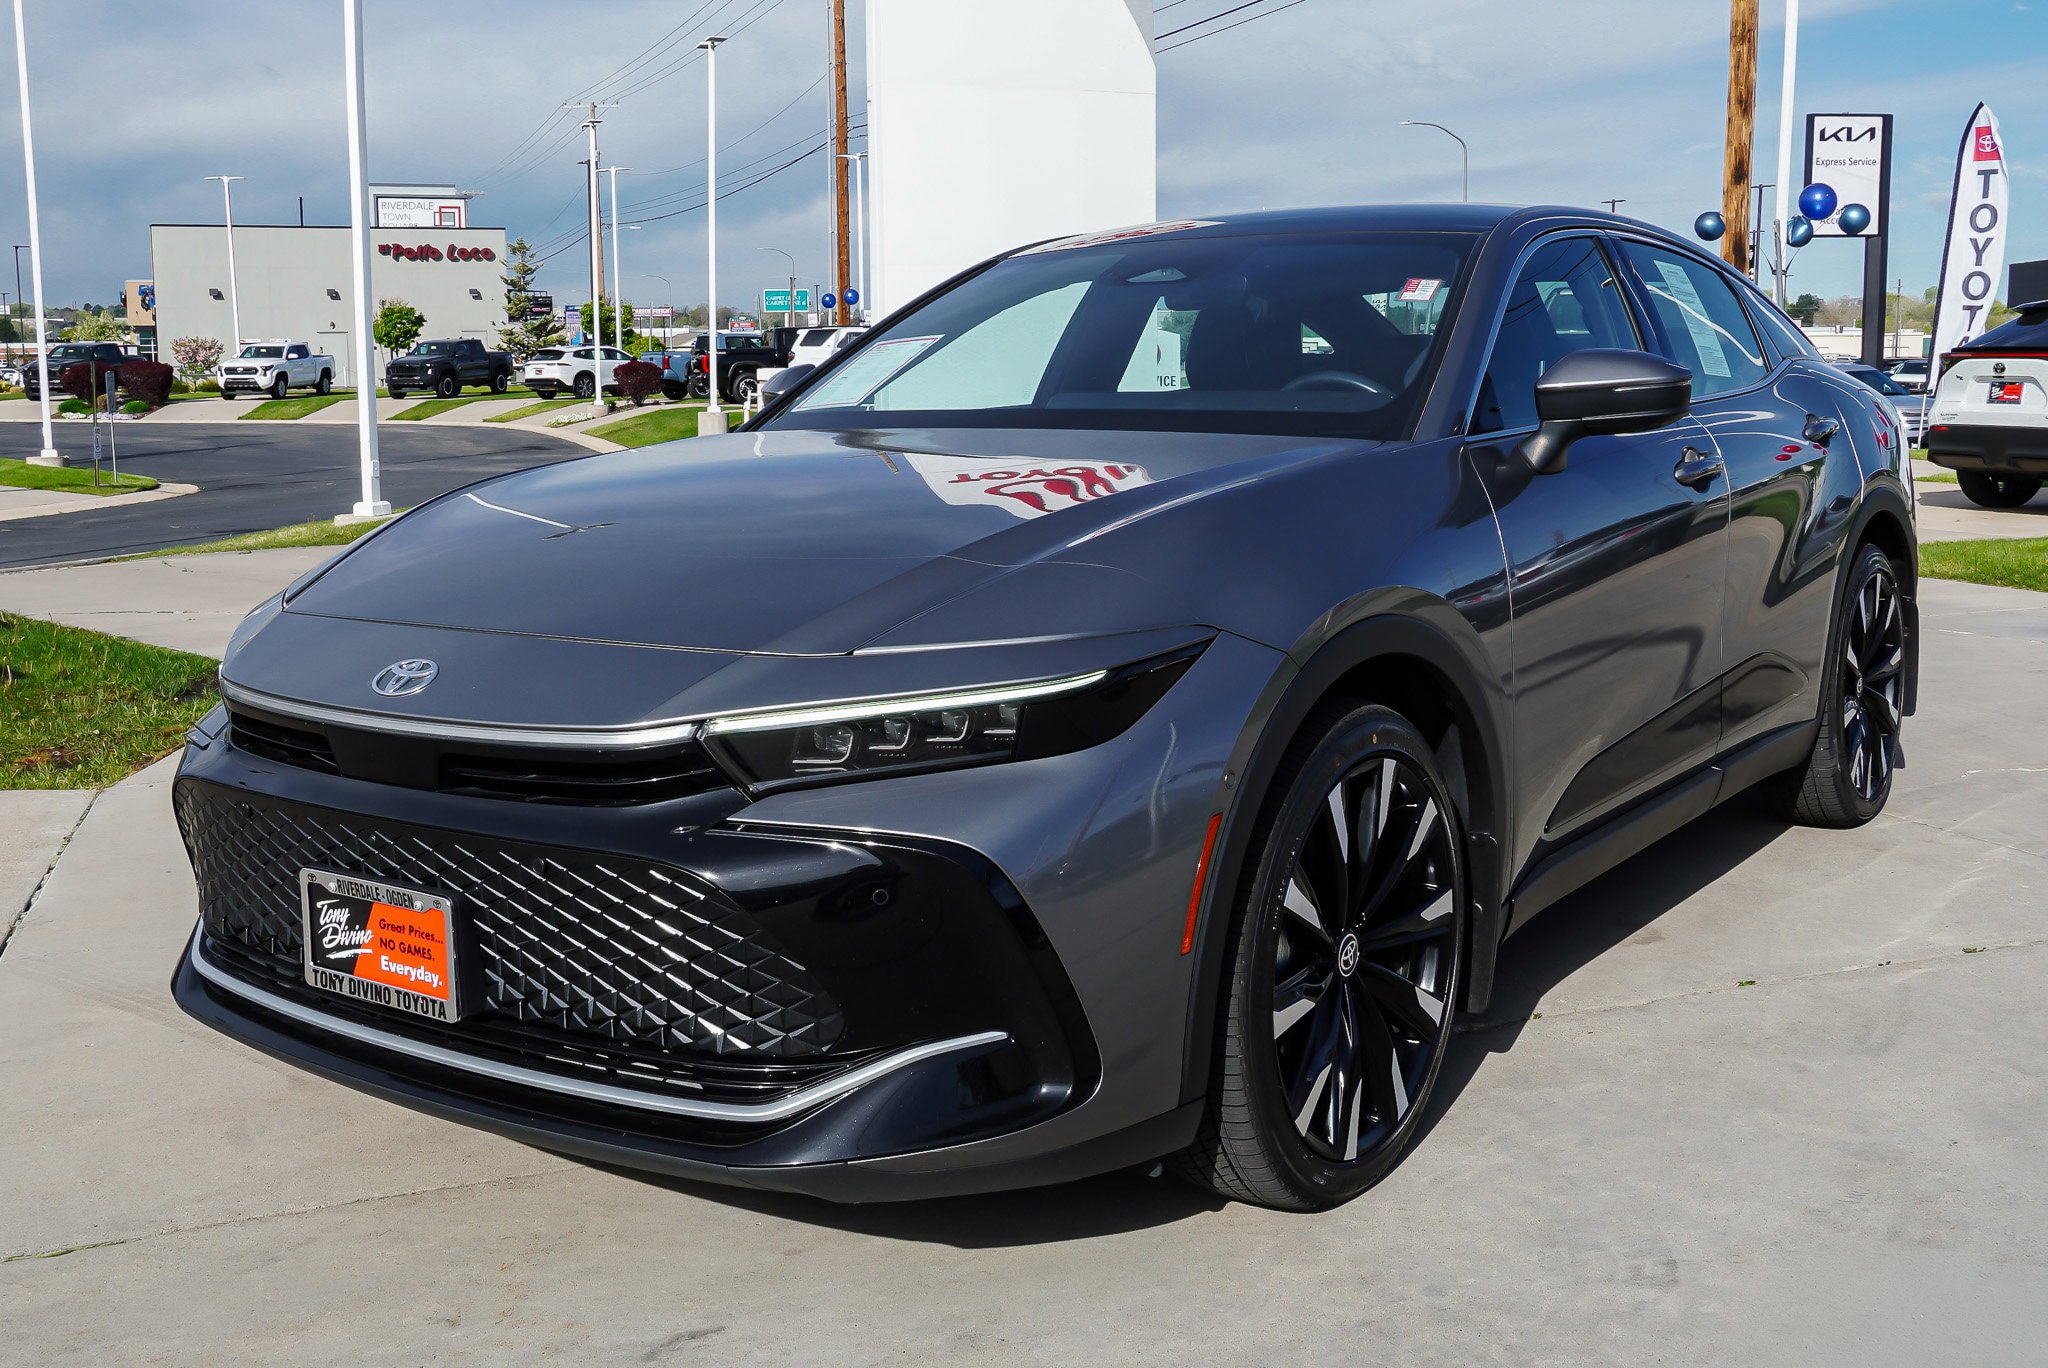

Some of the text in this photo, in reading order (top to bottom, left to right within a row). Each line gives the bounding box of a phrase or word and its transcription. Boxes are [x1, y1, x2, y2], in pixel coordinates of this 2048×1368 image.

[1819, 127, 1876, 142] KIA
[1816, 157, 1877, 167] Express Service
[381, 201, 434, 211] RIVERDALE
[382, 212, 411, 221] TOWN
[391, 243, 443, 262] Pollo
[447, 243, 496, 262] Loco
[336, 878, 381, 902] RIVERDALE
[386, 889, 414, 909] OGDEN
[316, 899, 350, 930] Tony
[318, 922, 374, 949] Divino
[379, 918, 444, 945] Great Prices...
[379, 937, 435, 962] NO GAMES.
[380, 955, 443, 988] Everyday.
[312, 968, 448, 1020] TONY DIVINO TOYOTA
